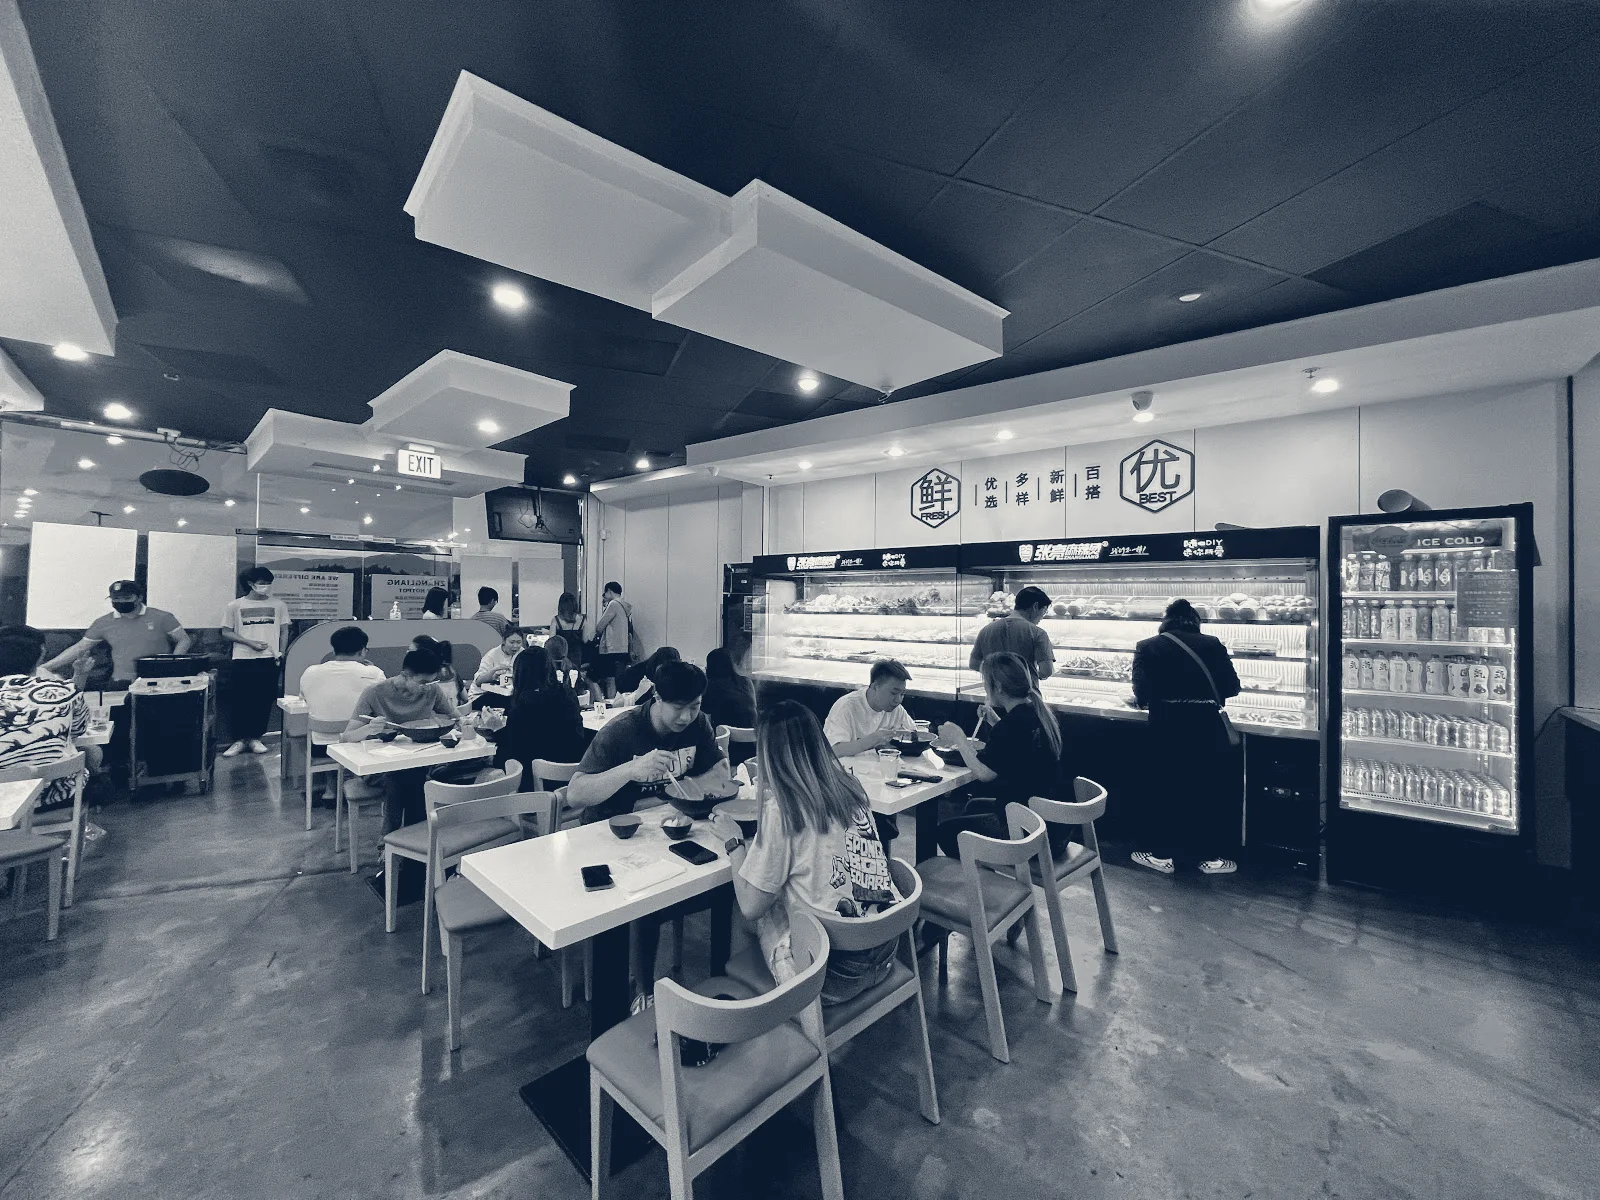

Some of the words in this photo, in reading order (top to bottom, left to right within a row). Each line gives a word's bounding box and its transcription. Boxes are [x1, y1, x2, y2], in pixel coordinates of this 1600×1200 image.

[408, 454, 435, 475] EXIT
[1129, 448, 1181, 494] 优
[918, 474, 953, 511] 鲜
[984, 476, 998, 509] 优选
[1015, 472, 1030, 507] 多样
[1049, 469, 1065, 504] 新鲜
[1085, 465, 1101, 501] 百搭
[1138, 491, 1177, 505] BEST
[920, 510, 950, 521] FRESH
[1417, 538, 1441, 547] ICE
[1444, 536, 1485, 546] COLD
[596, 705, 605, 715] 10
[847, 851, 888, 877] BOB
[850, 869, 892, 891] SQUARE
